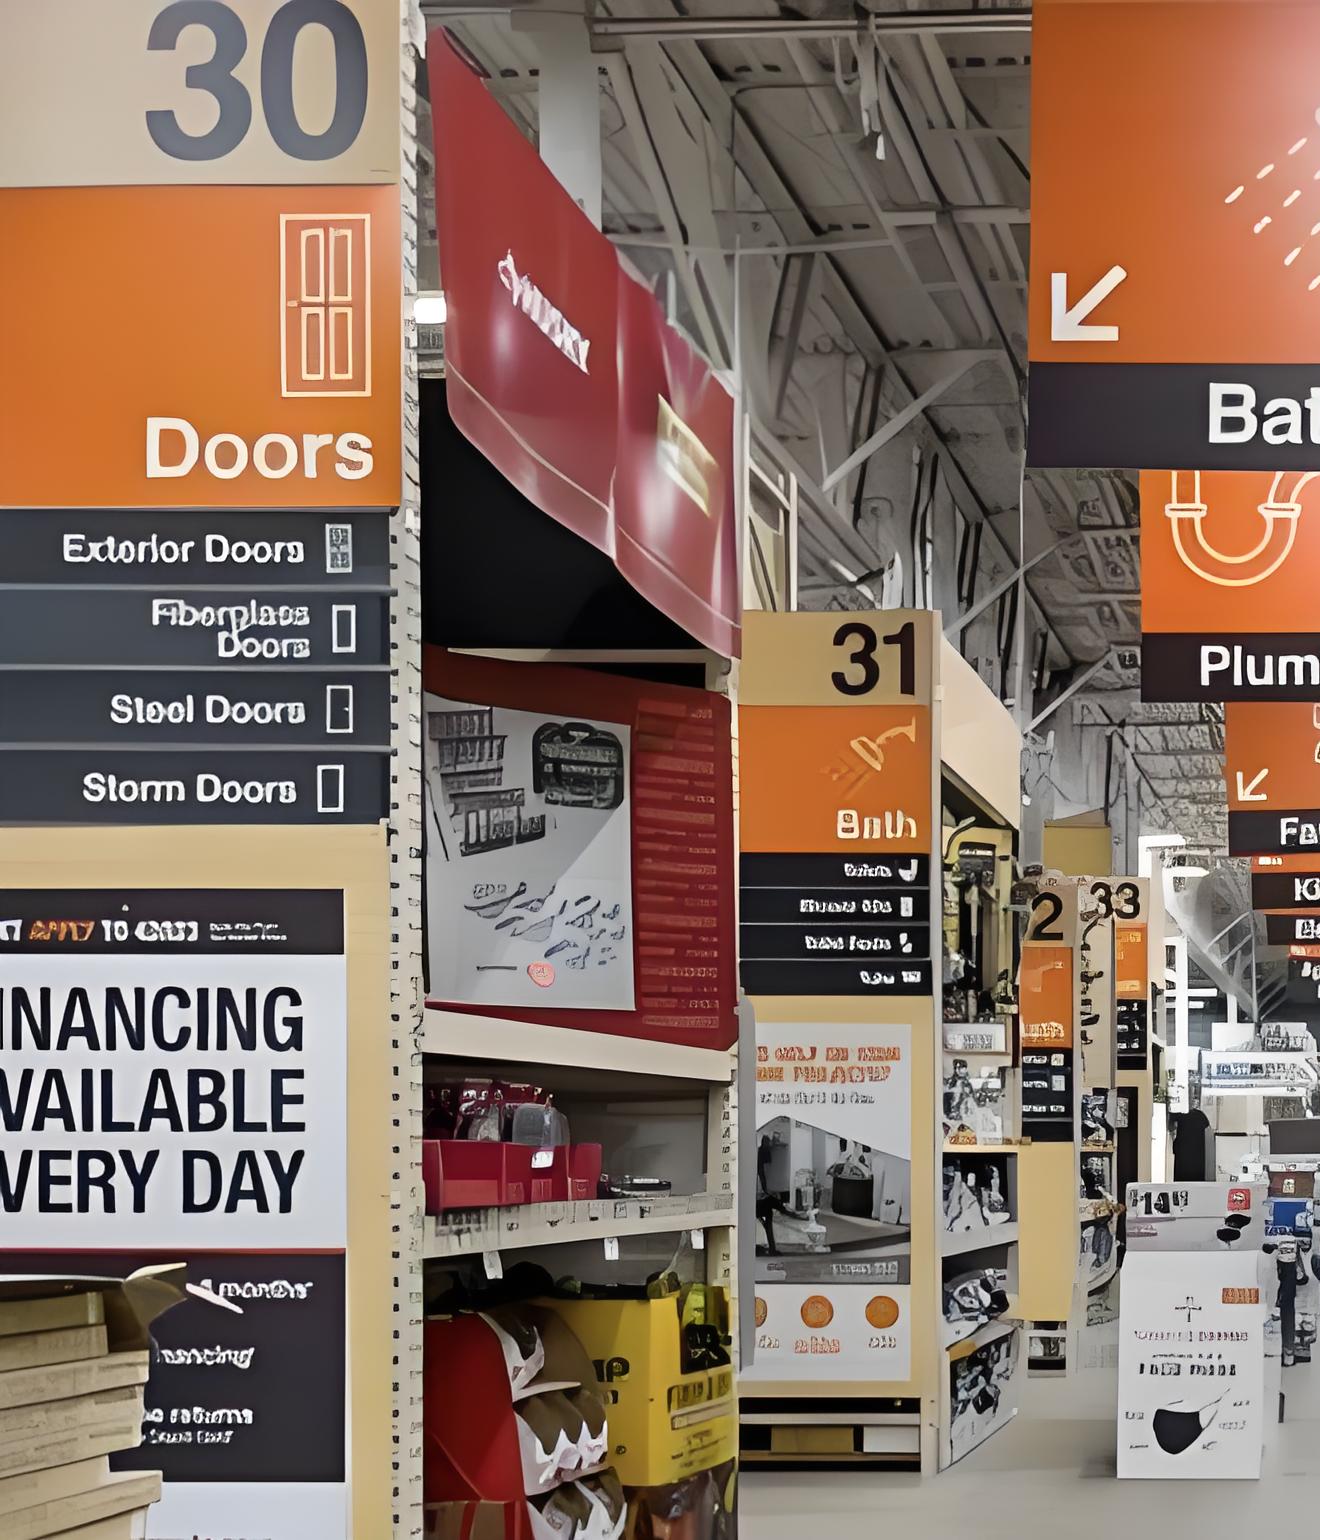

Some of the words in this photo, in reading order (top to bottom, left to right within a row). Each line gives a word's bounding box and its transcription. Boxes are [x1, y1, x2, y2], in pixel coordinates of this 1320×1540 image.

[146, 0, 368, 161] 30
[146, 417, 373, 479] Doors
[205, 534, 304, 563] Doors
[831, 622, 915, 696] 31
[205, 695, 305, 724] Doors
[83, 773, 185, 802] Storm
[197, 774, 296, 803] Doors
[1090, 882, 1140, 919] 33
[0, 987, 303, 1051] NANCING
[0, 1068, 305, 1132] VAILABLE
[0, 1149, 160, 1213] VERY
[182, 1149, 305, 1213] DAY
